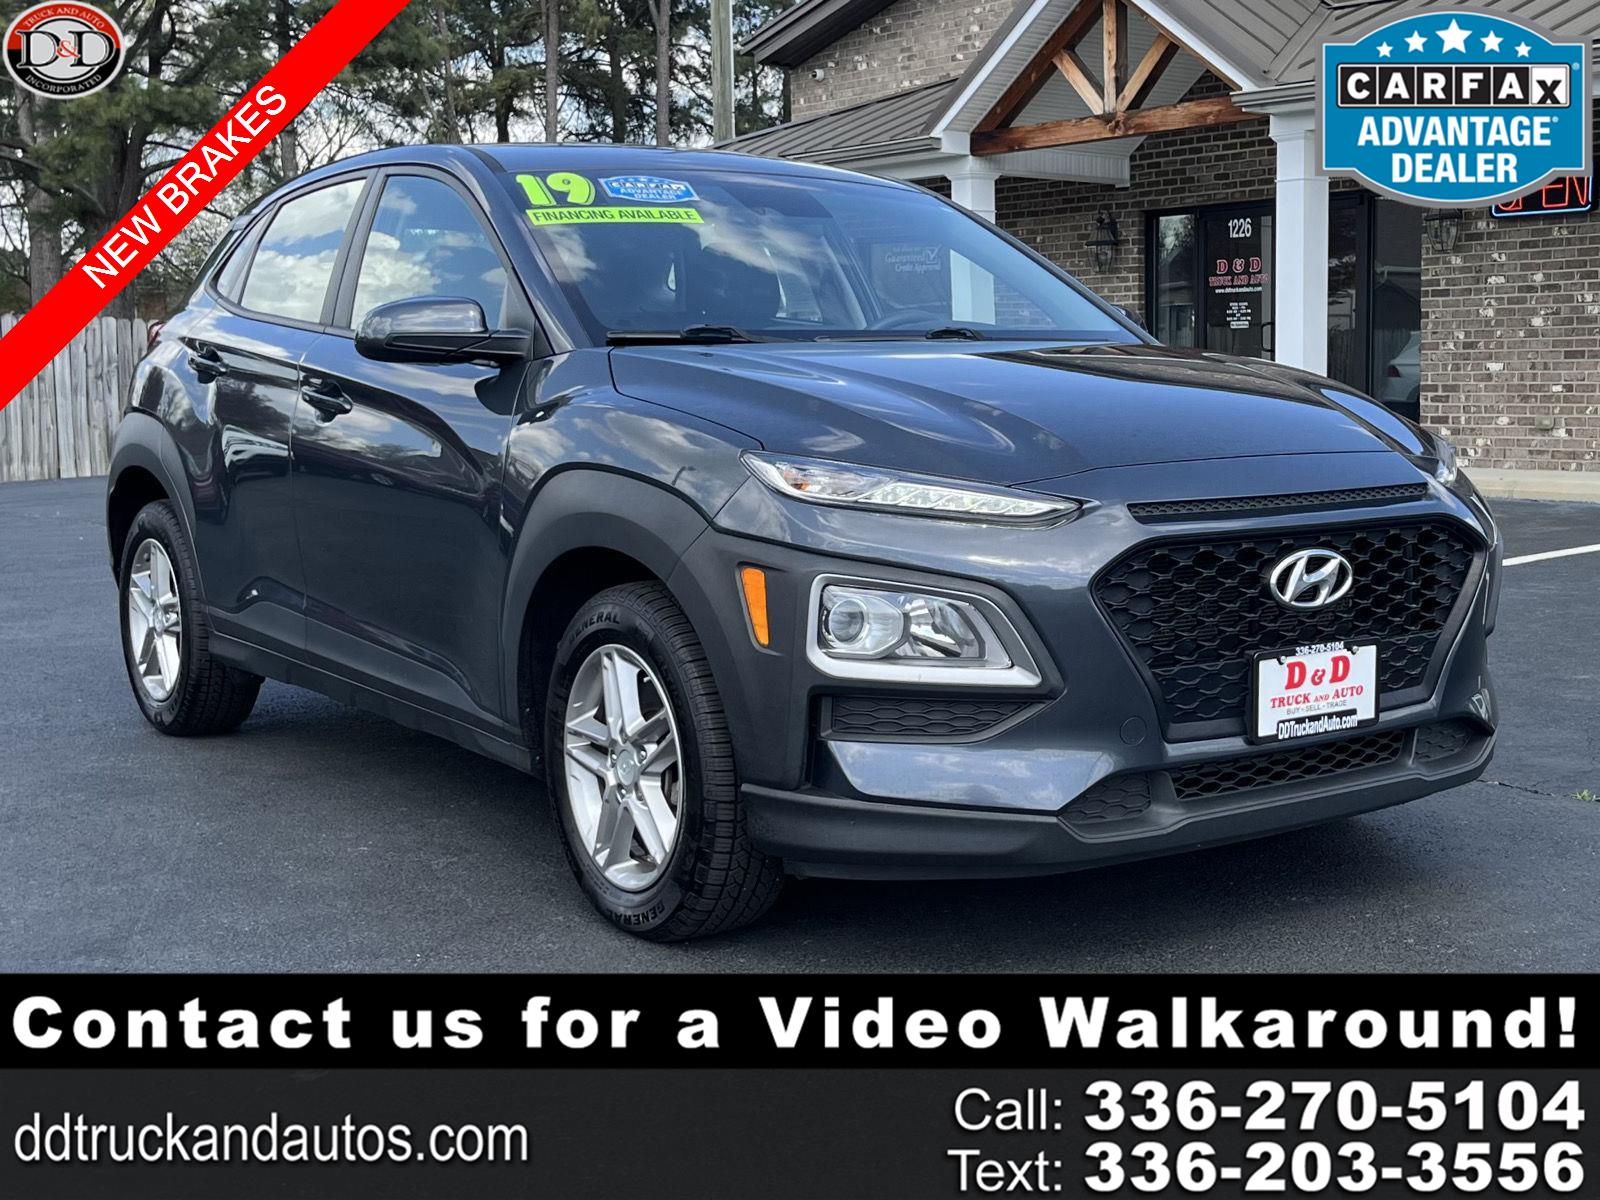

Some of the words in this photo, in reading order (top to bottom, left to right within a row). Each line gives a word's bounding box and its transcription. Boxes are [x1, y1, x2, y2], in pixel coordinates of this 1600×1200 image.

[515, 172, 596, 206] 19
[633, 192, 677, 201] DEALER
[533, 209, 614, 222] FINANCING
[618, 208, 697, 221] AVAILABLE
[1228, 218, 1252, 238] 1226
[1216, 259, 1229, 274] D
[1249, 257, 1262, 272] D
[1233, 274, 1249, 286] AND
[1295, 641, 1345, 657] 336-270-5104
[1285, 661, 1307, 690] D
[1311, 668, 1326, 686] &
[1329, 655, 1350, 684] D
[1270, 692, 1312, 709] TRUCK
[1313, 693, 1329, 703] AND
[1332, 685, 1364, 700] AUTO
[1278, 714, 1358, 740] DDTruckandAuto.com
